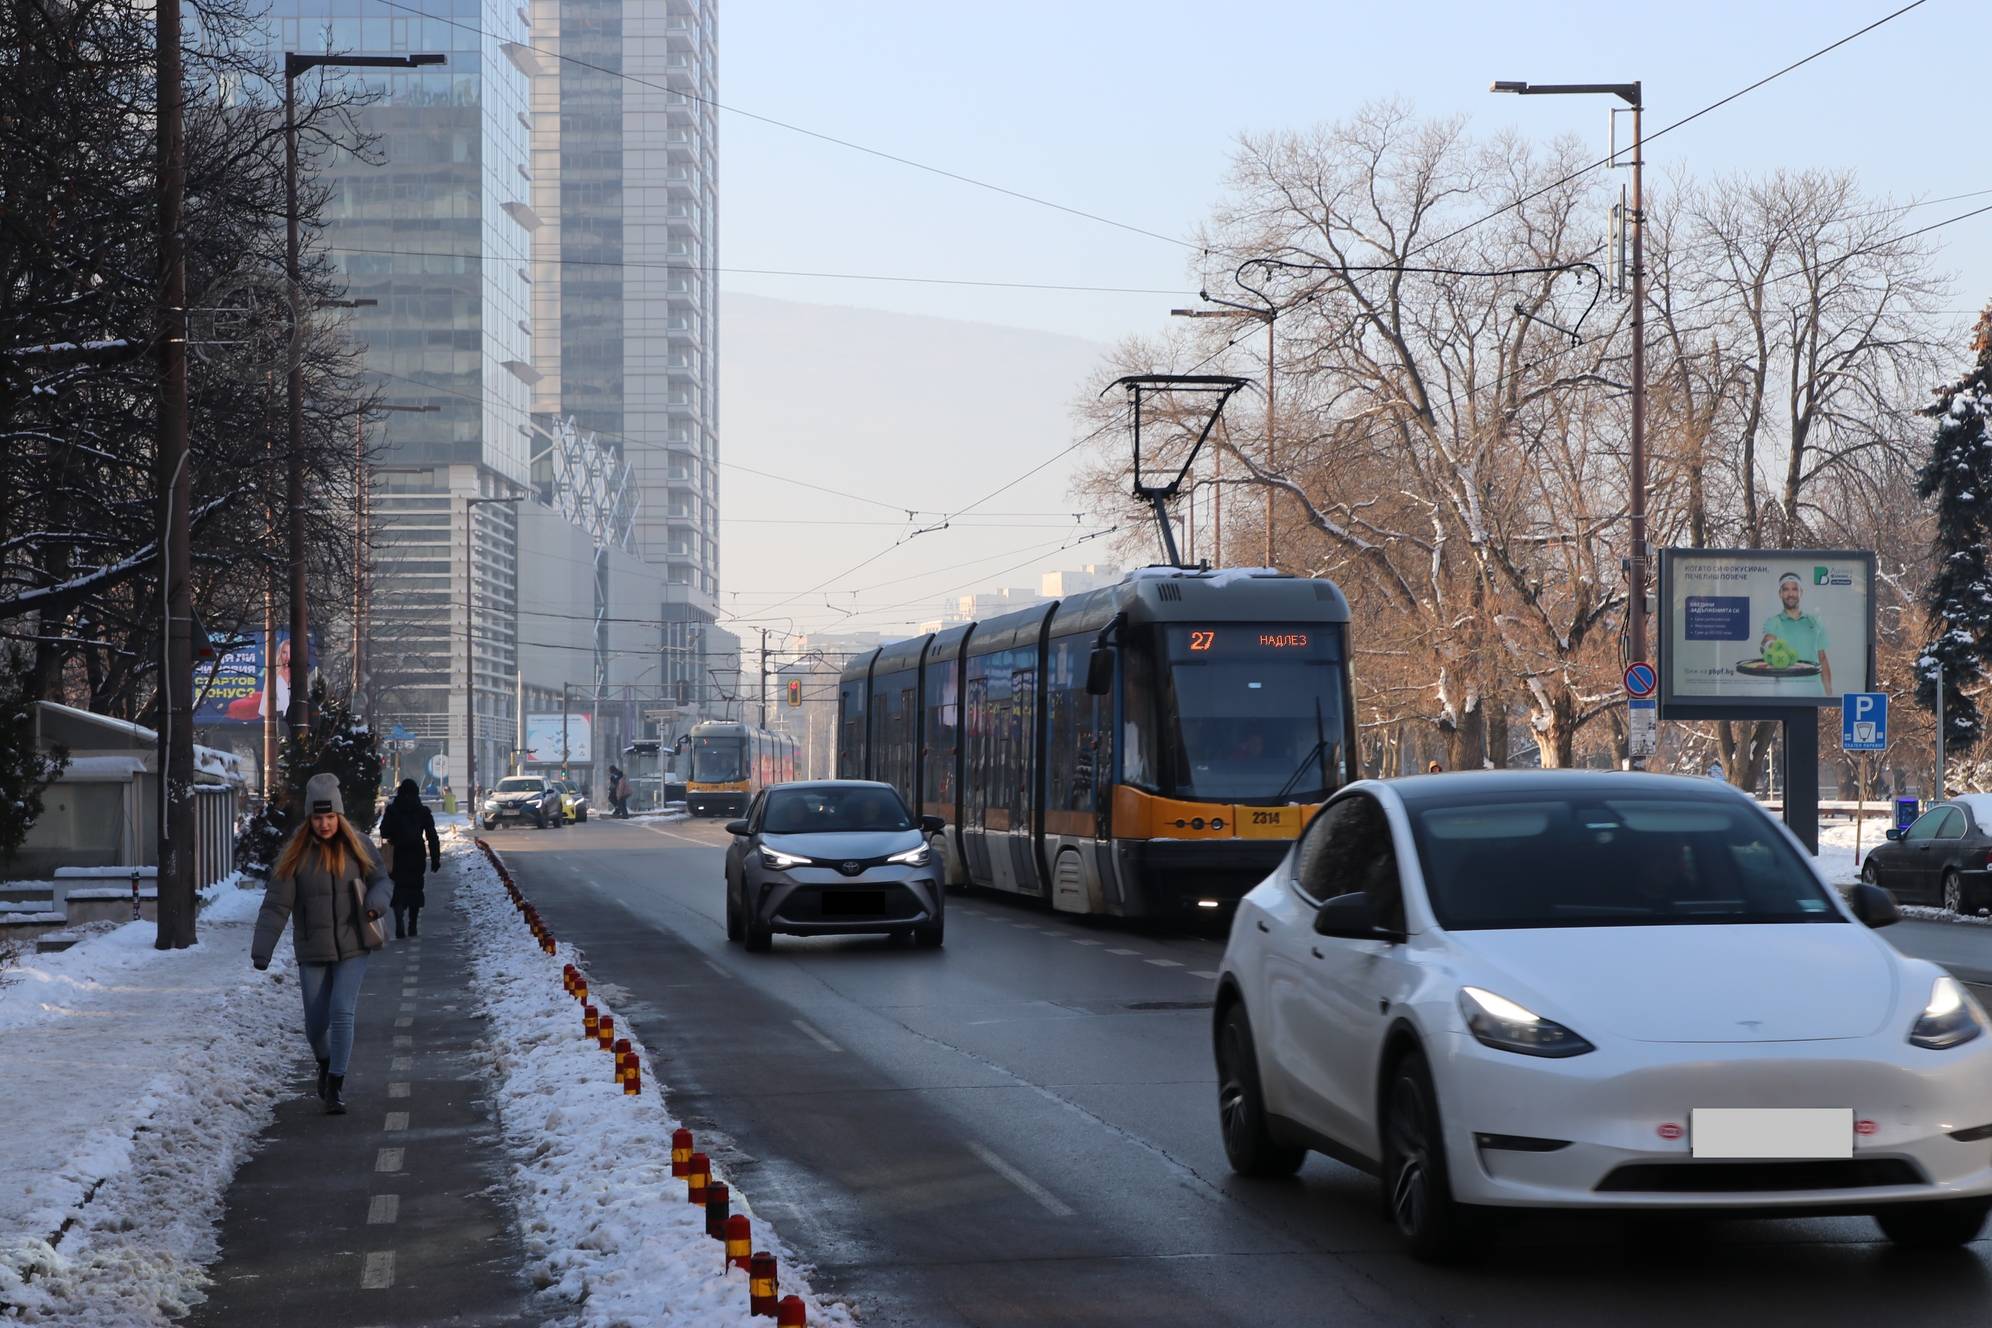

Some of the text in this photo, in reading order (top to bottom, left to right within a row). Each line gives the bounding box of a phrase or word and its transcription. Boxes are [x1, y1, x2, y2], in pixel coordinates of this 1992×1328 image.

[1190, 631, 1214, 650] 27
[1259, 635, 1307, 647] НАДЛЕЗ
[1856, 696, 1874, 721] P
[1252, 812, 1280, 824] 2314
